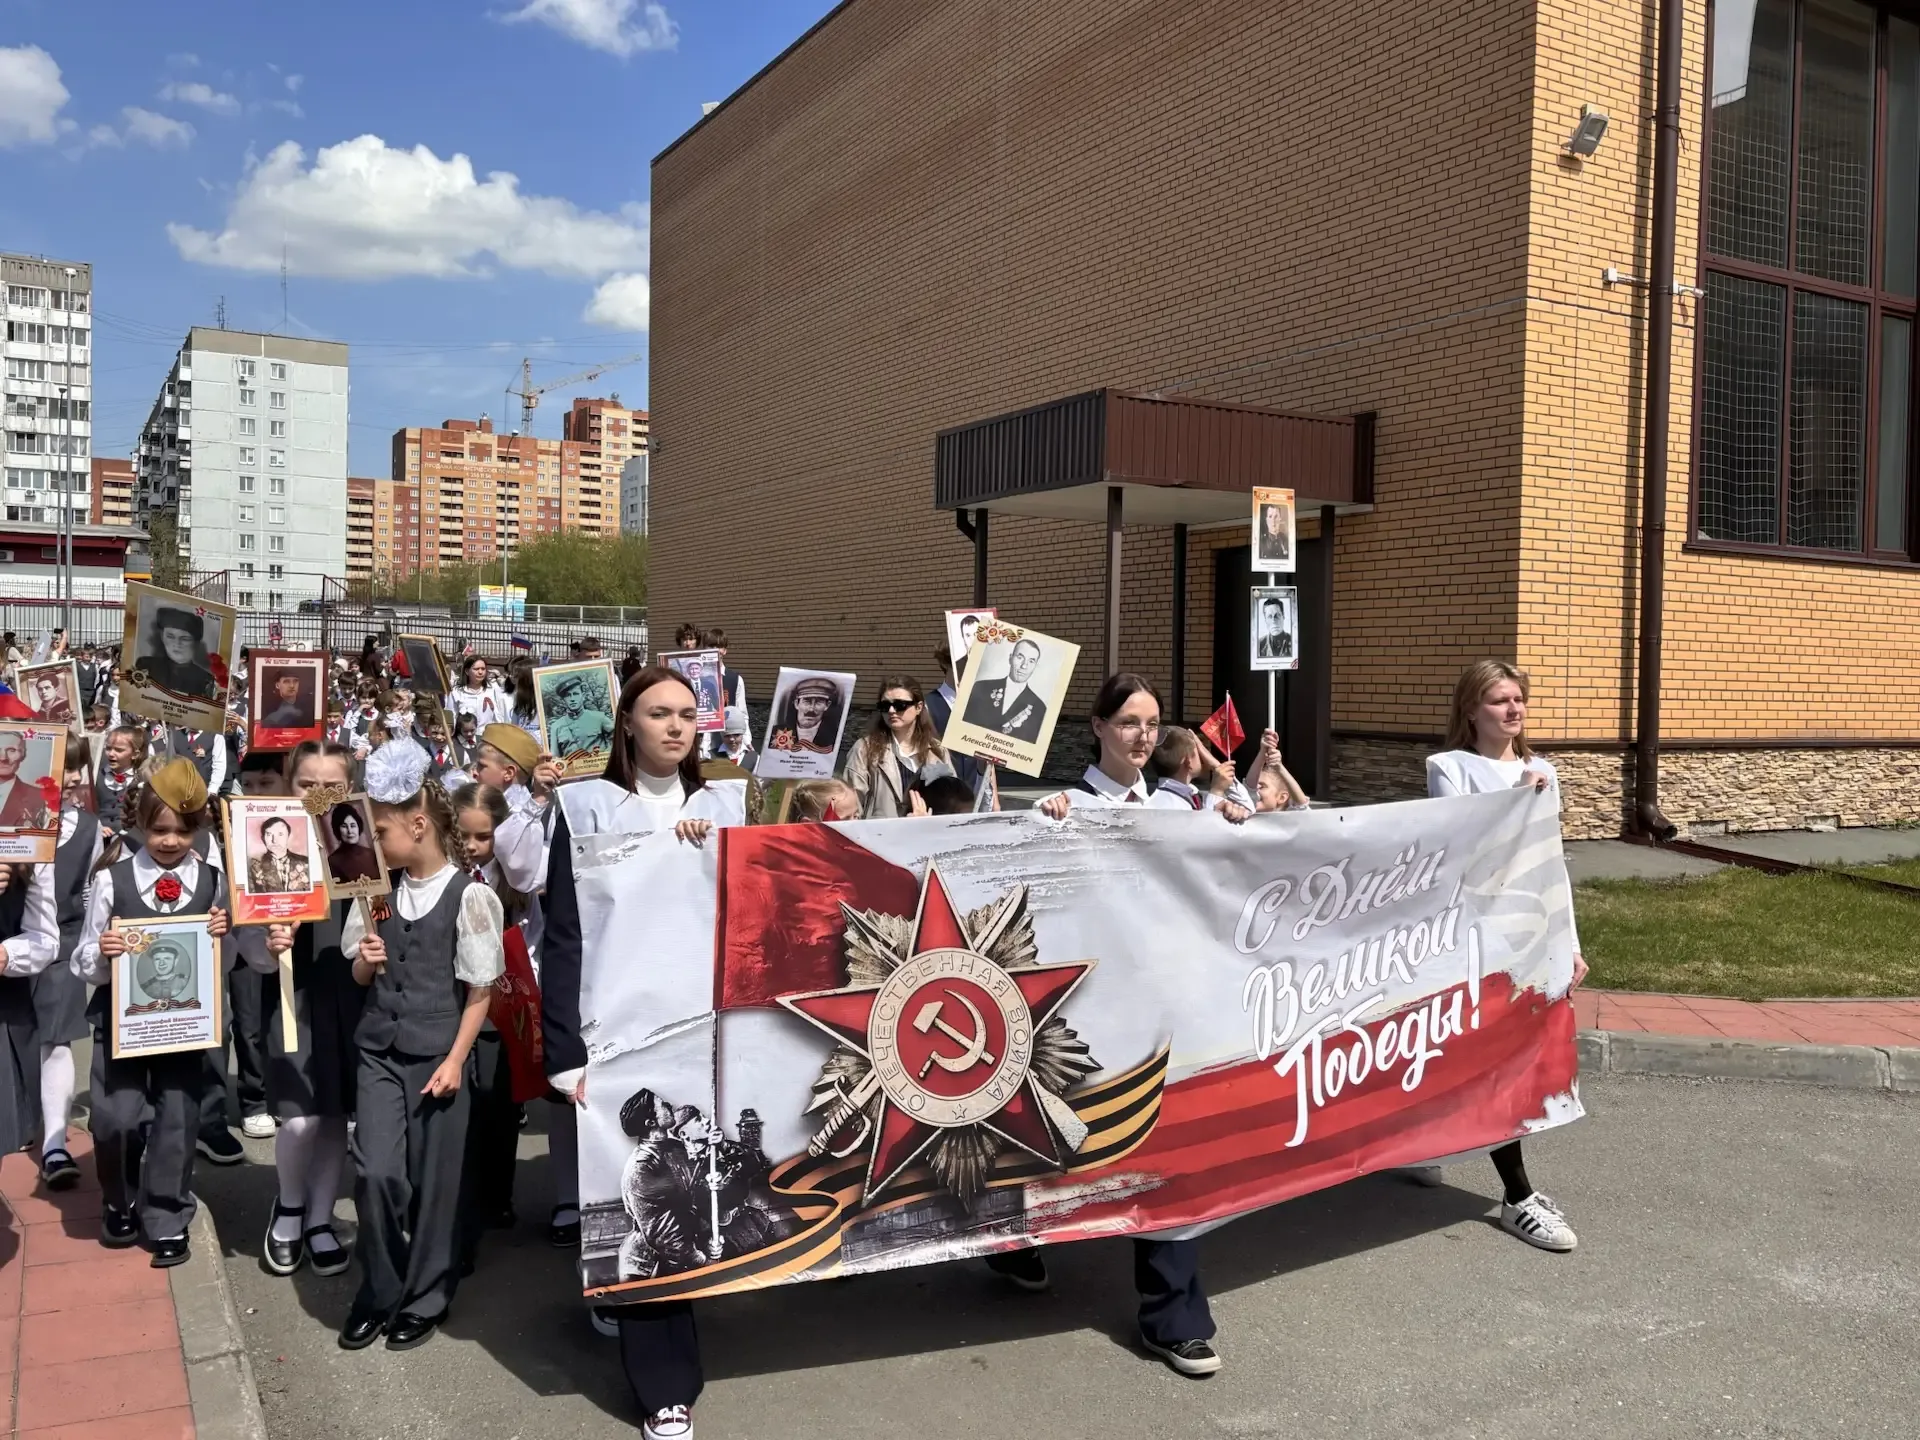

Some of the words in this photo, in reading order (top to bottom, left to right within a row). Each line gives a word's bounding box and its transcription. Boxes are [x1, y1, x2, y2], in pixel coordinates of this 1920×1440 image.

[961, 734, 991, 749] Алексей
[991, 743, 1034, 763] Васильевич
[984, 733, 1015, 748] Карасев
[1233, 877, 1294, 955] С
[1292, 842, 1446, 942] Днём
[875, 953, 1010, 1112] ОТЕЧЕСТВЕННАЯ
[1242, 876, 1462, 1062] Великой
[1273, 926, 1481, 1148] Победы!
